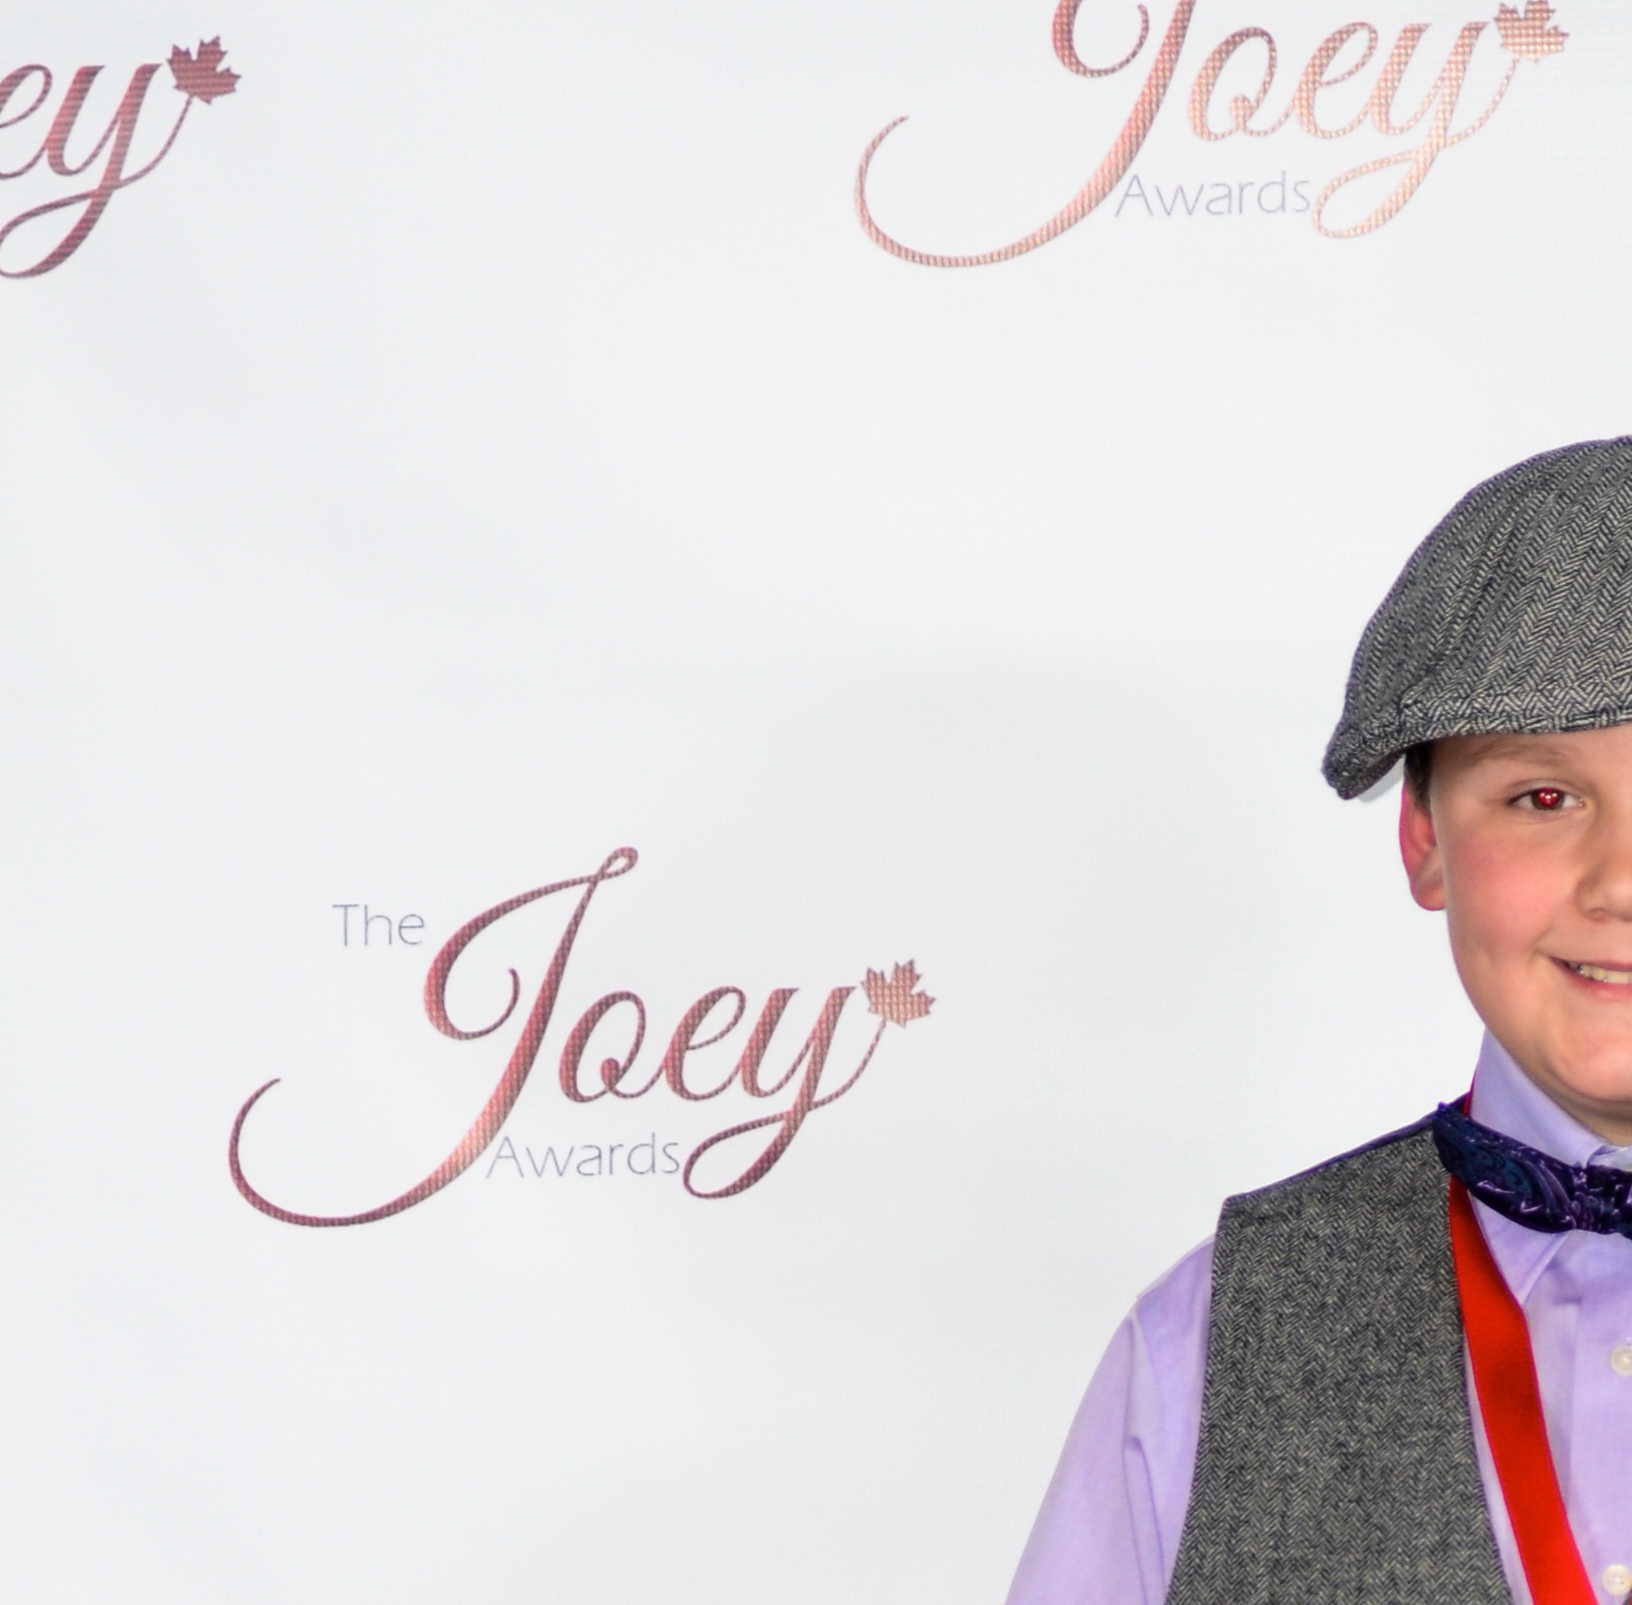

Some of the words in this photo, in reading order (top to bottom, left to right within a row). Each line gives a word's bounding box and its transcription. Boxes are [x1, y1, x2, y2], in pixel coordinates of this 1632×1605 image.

[0, 64, 192, 279] ey
[1115, 169, 1311, 220] Awards
[332, 903, 425, 947] The
[228, 846, 886, 1228] Joey
[486, 1132, 681, 1179] Awards
